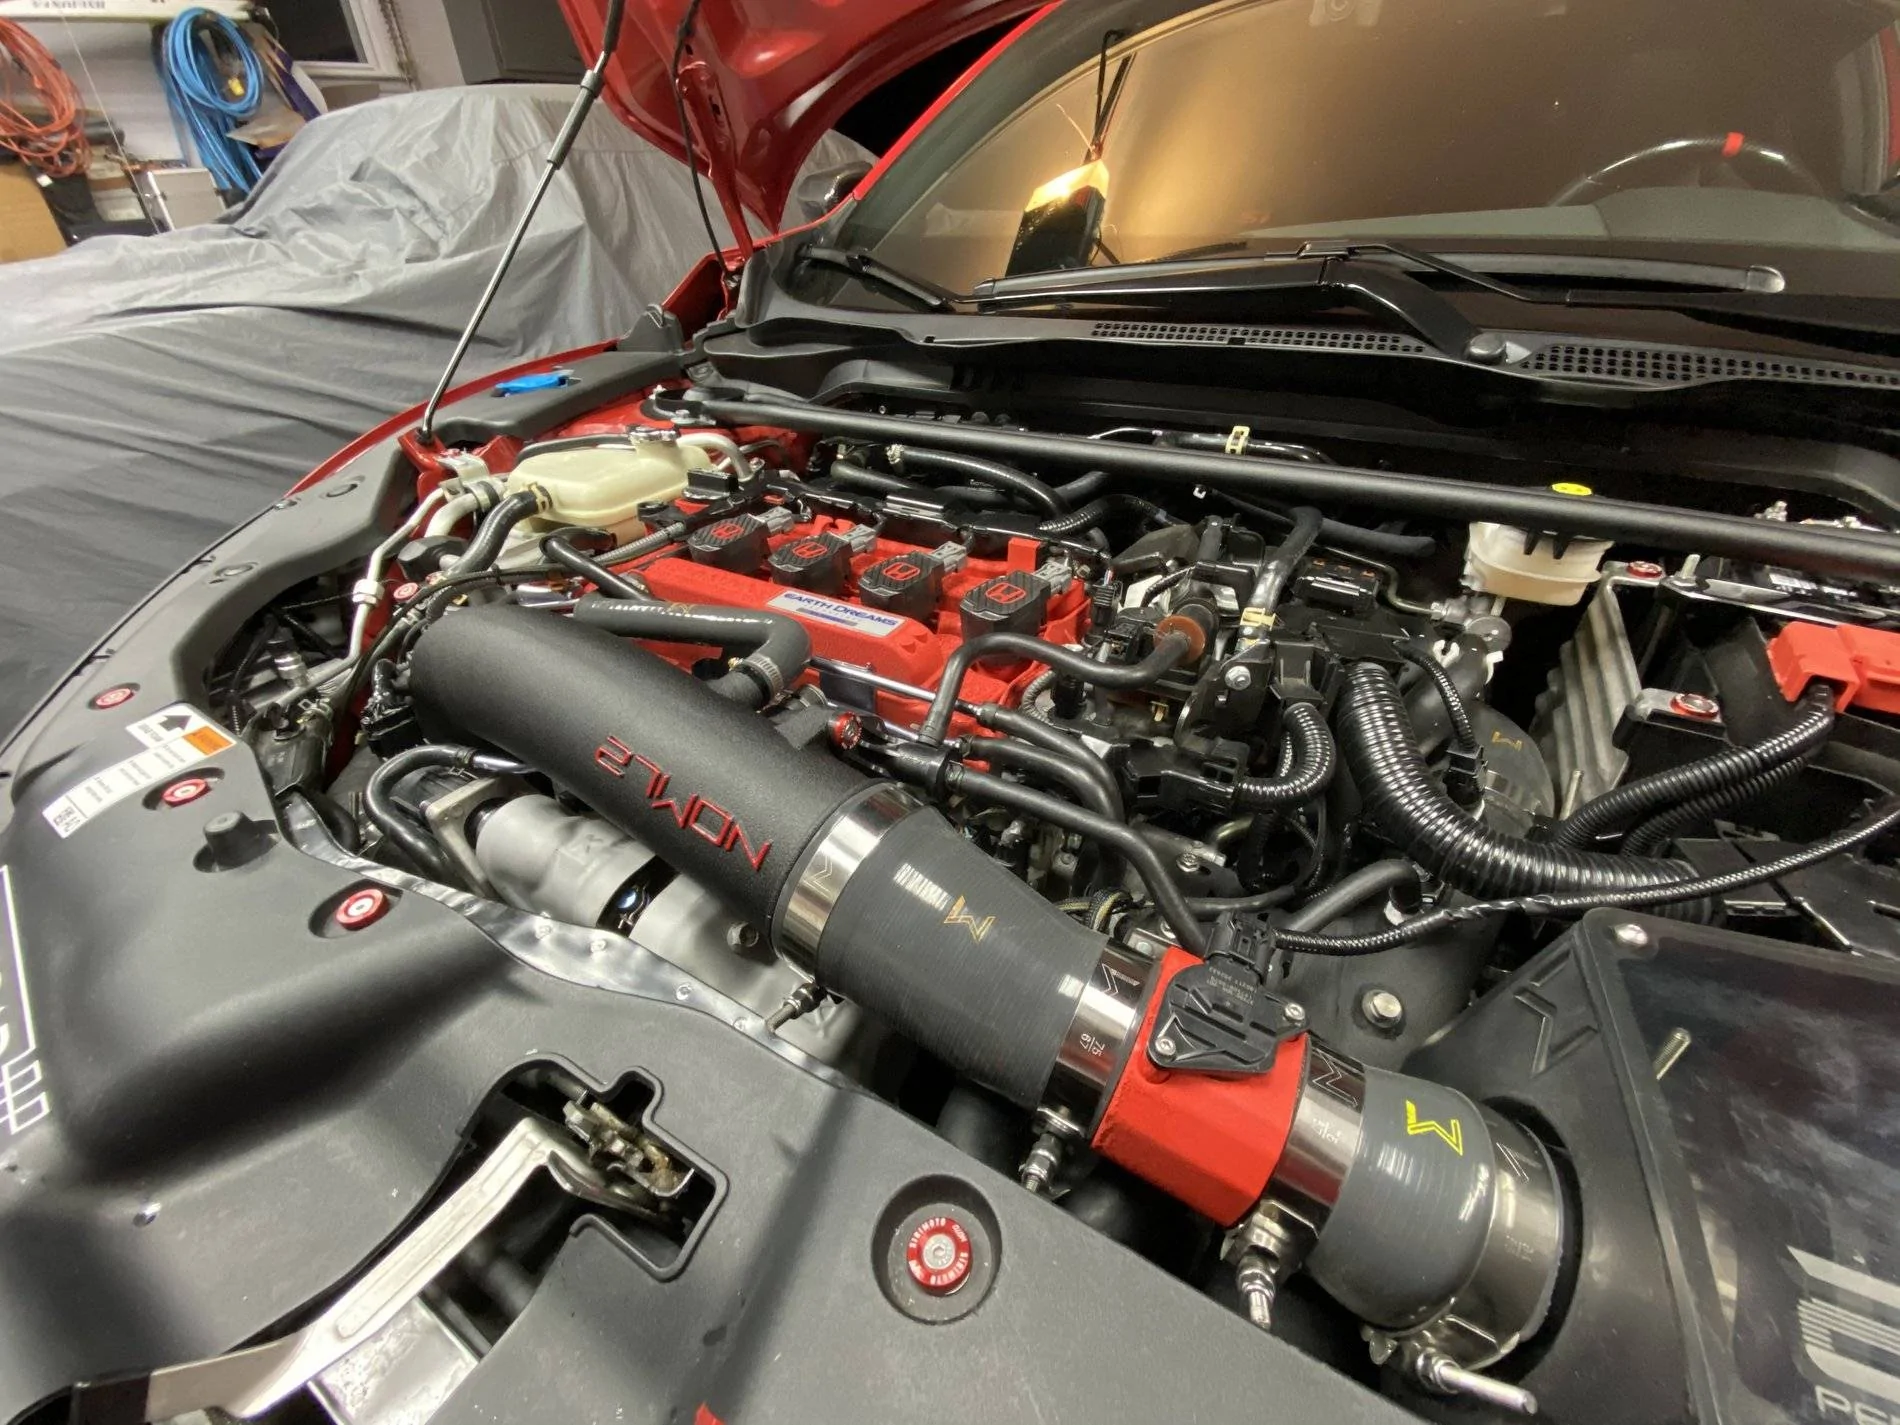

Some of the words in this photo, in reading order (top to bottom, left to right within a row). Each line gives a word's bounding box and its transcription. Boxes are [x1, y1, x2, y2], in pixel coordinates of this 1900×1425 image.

[784, 593, 833, 609] EARTH
[834, 605, 898, 626] DREAMS
[594, 735, 772, 871] 27WON
